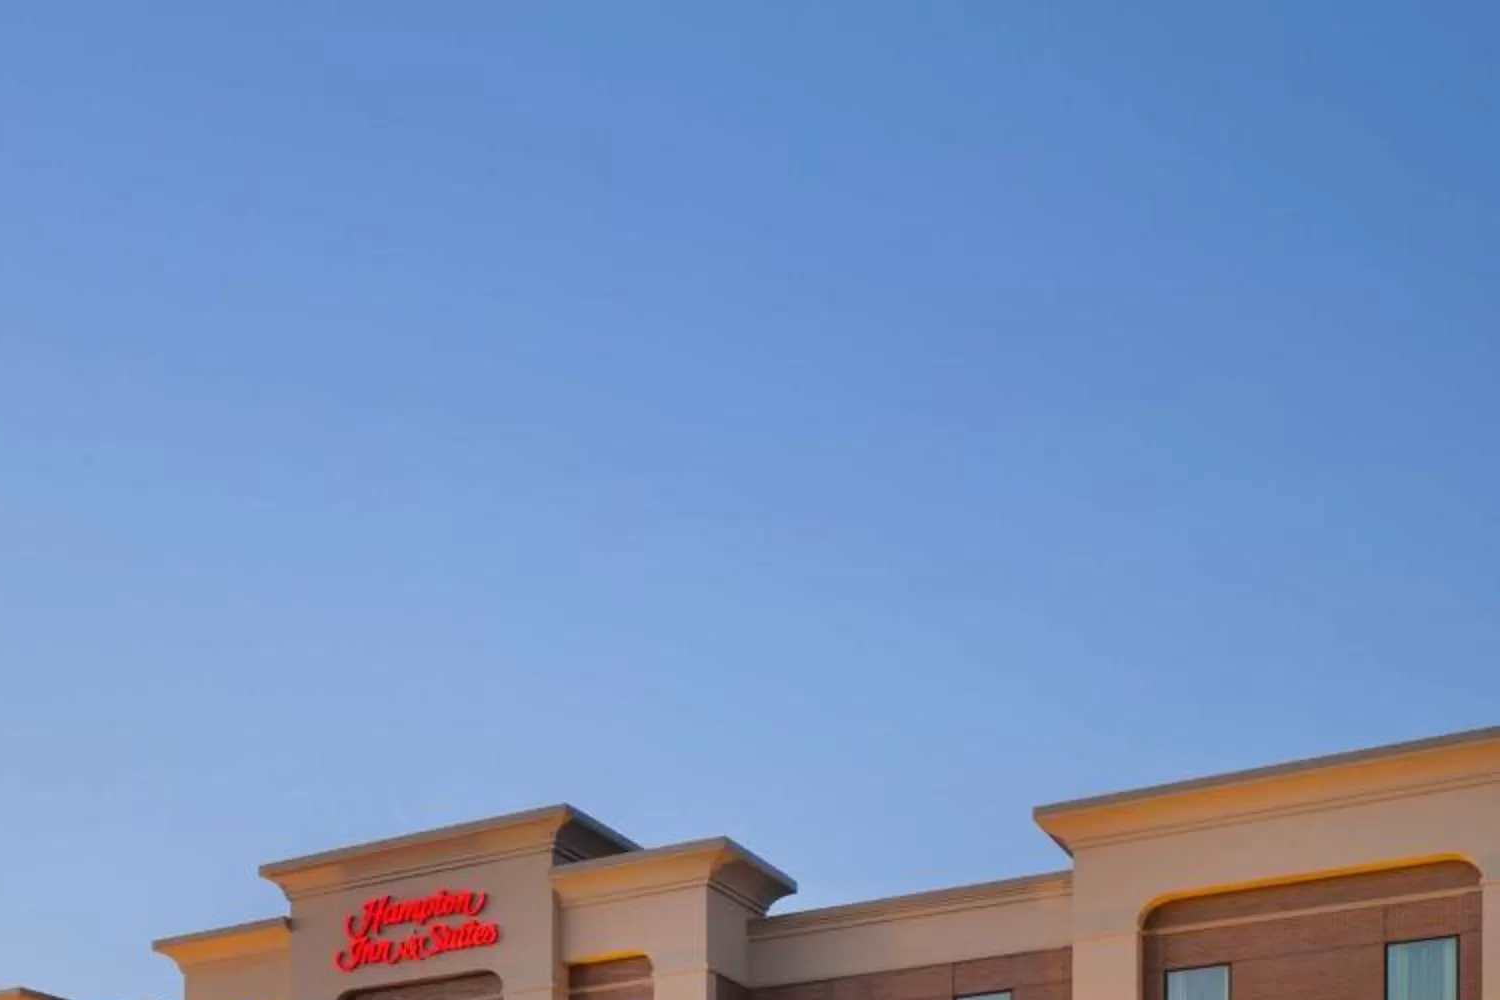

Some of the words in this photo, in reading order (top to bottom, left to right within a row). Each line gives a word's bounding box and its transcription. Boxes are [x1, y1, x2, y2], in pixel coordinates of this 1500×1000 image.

[345, 889, 488, 937] Hampton
[334, 935, 400, 973] Inn
[419, 920, 499, 957] Suites
